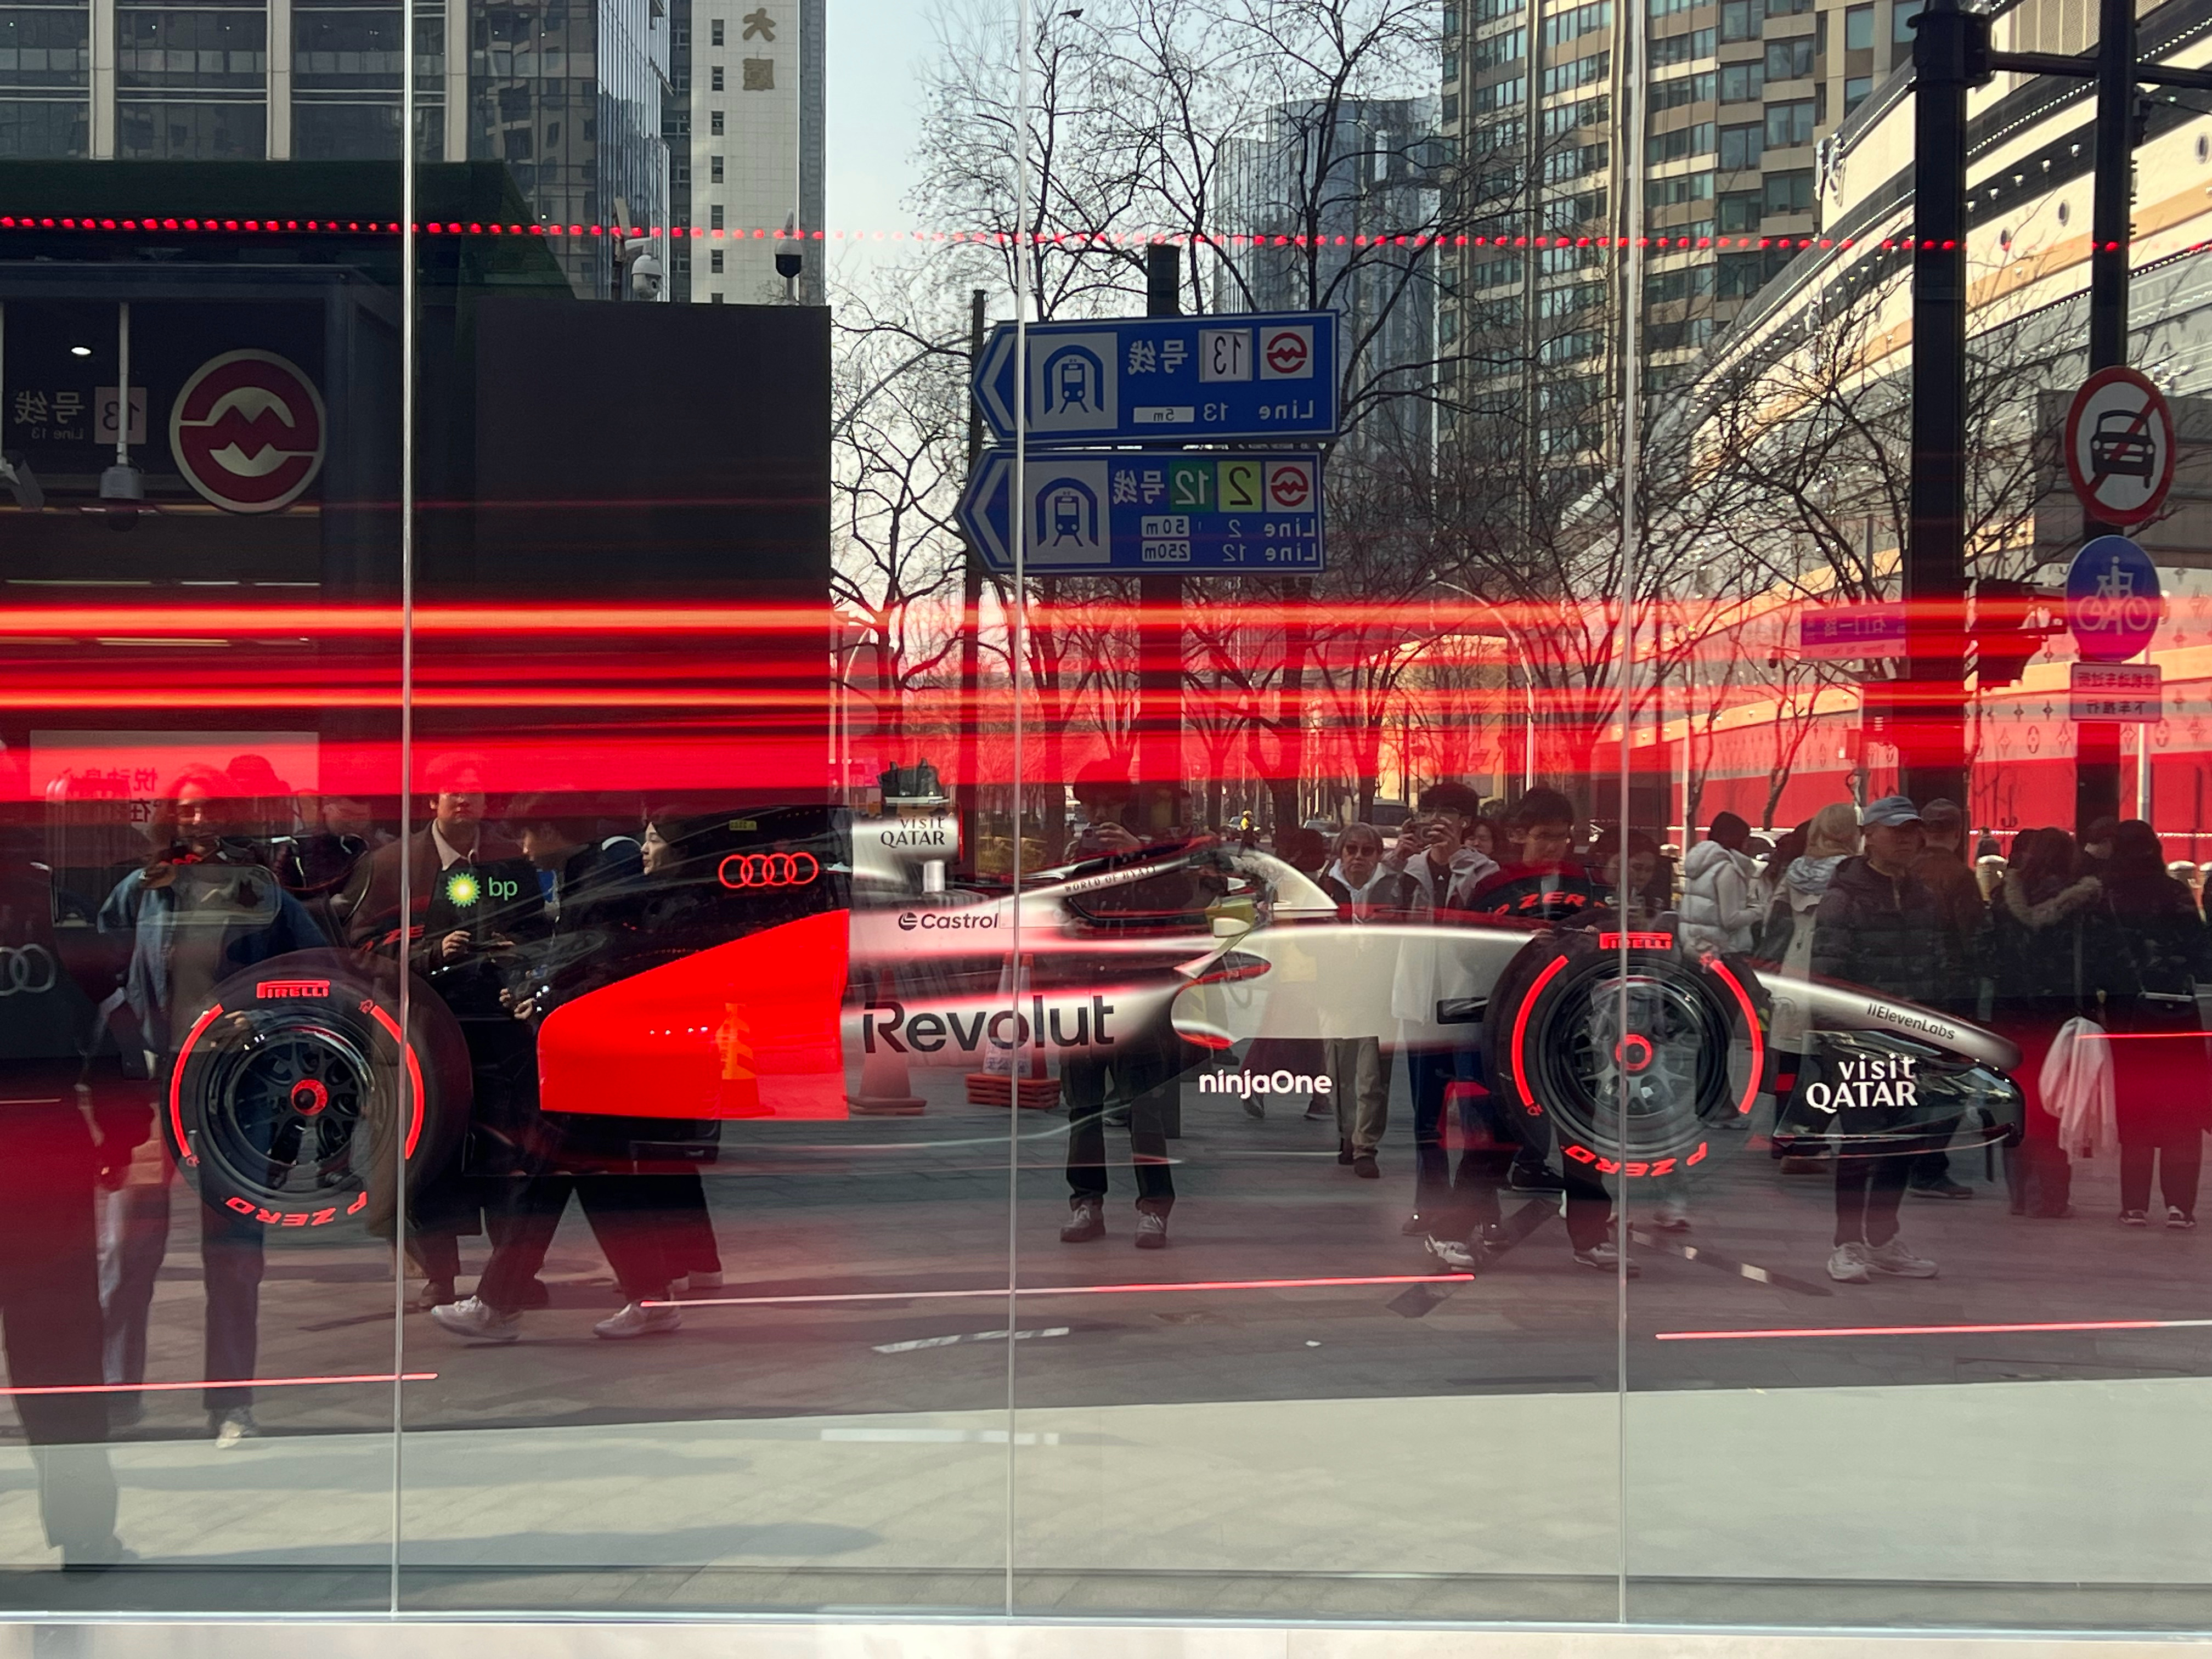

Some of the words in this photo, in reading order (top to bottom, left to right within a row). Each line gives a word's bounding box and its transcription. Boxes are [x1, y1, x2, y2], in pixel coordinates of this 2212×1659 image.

[880, 830, 946, 848] QATAR
[487, 877, 518, 901] bp
[921, 913, 999, 929] Castrol
[1599, 932, 1672, 950] PIRELLI
[256, 980, 330, 998] PIRELLI
[862, 995, 1114, 1053] Revolut
[1199, 1069, 1332, 1099] ninjaOne
[1806, 1081, 1918, 1114] QATAR
[1565, 1146, 1678, 1177] ZERO
[1686, 1142, 1707, 1166] P
[225, 1197, 336, 1227] ZERO
[347, 1191, 367, 1215] P
